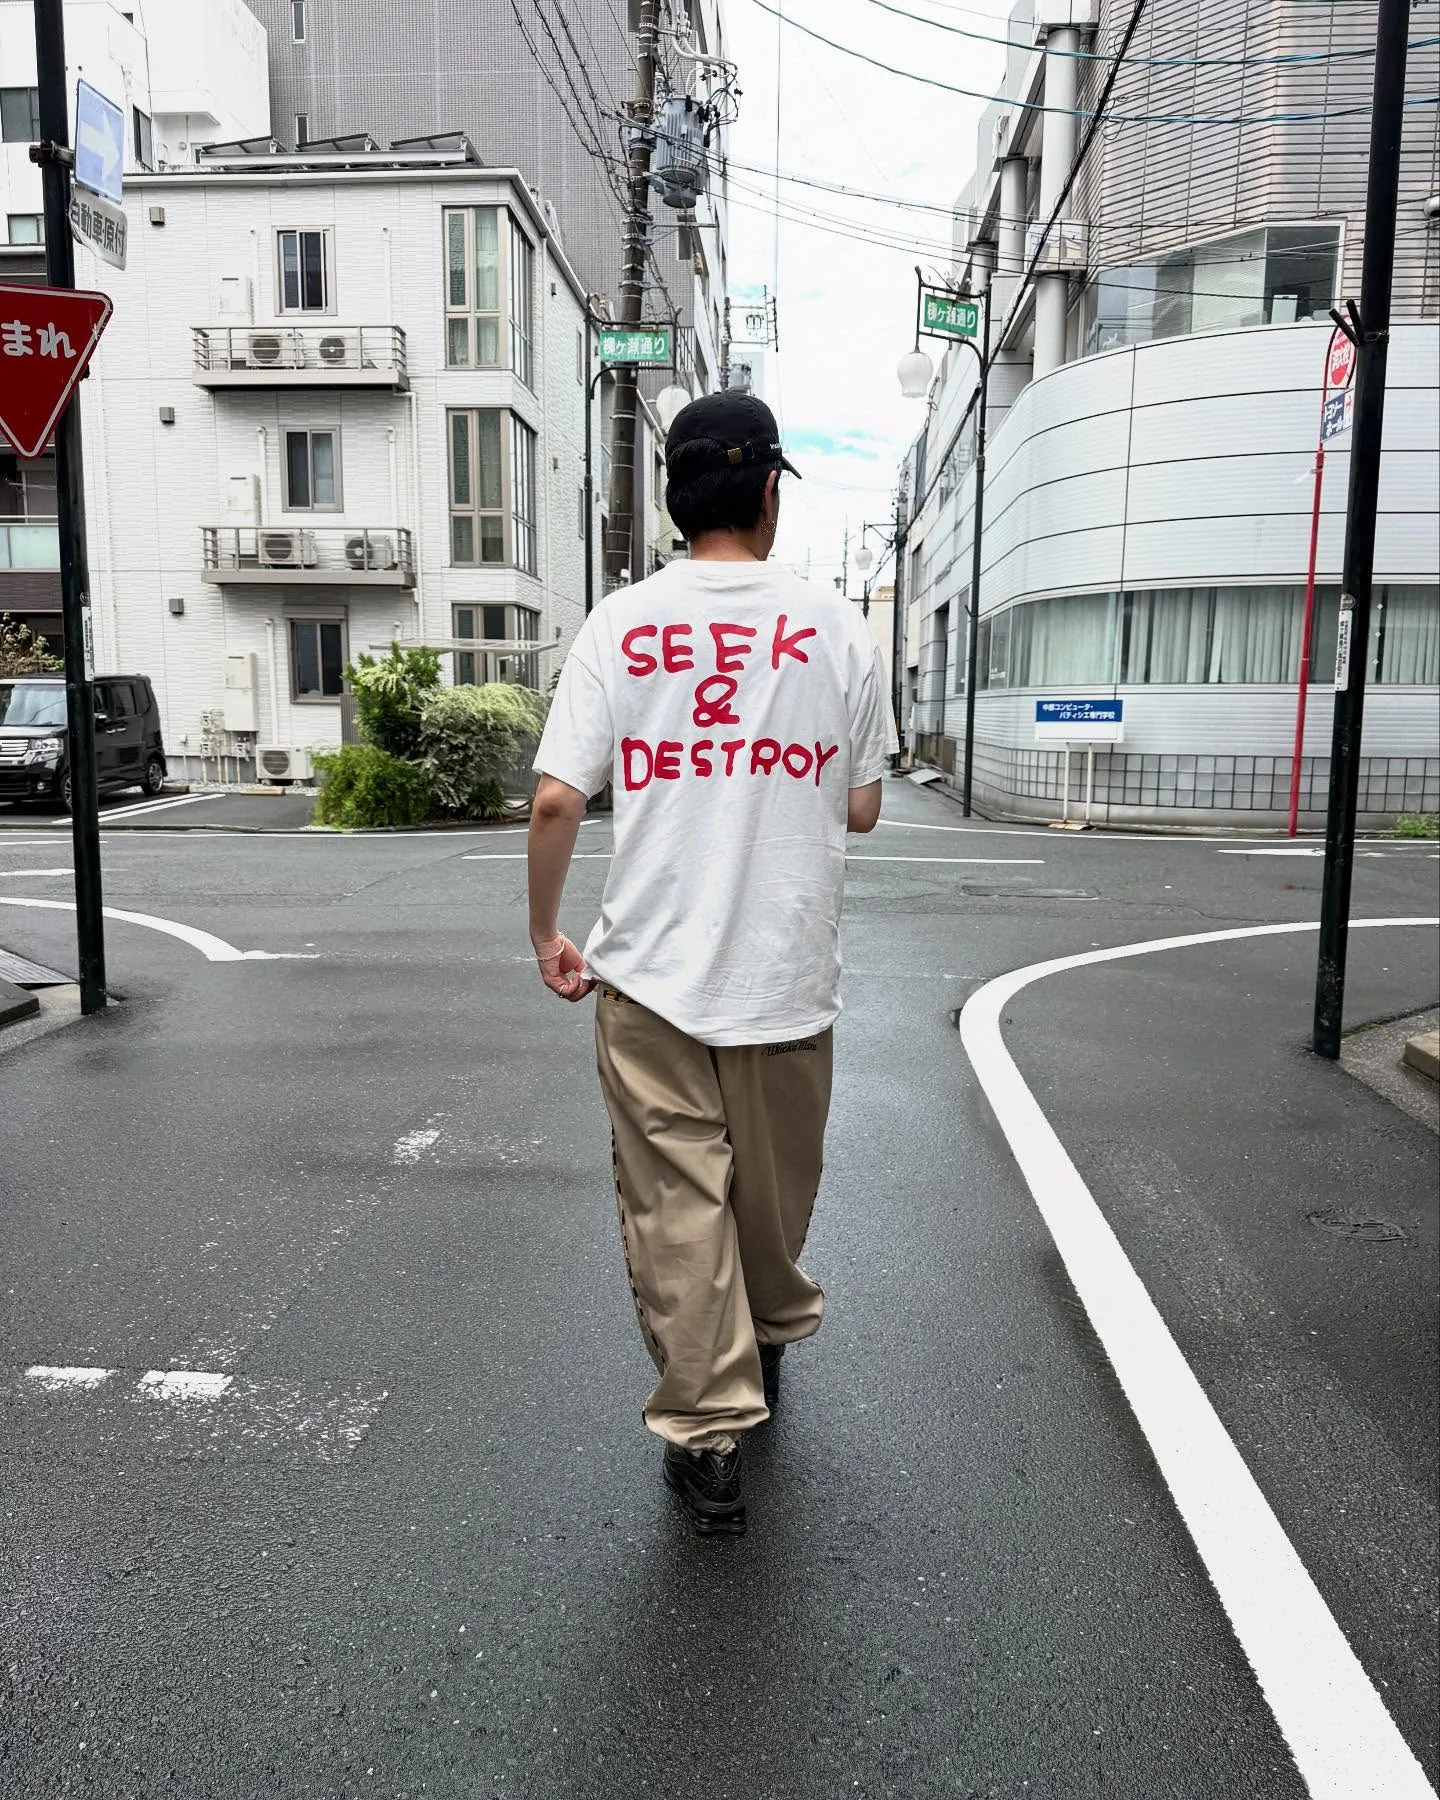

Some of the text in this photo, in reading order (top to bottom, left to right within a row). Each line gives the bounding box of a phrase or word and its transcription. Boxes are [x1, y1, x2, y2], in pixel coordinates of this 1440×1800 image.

[622, 615, 816, 677] SEEK
[693, 674, 740, 728] &
[621, 737, 839, 791] DESTROY
